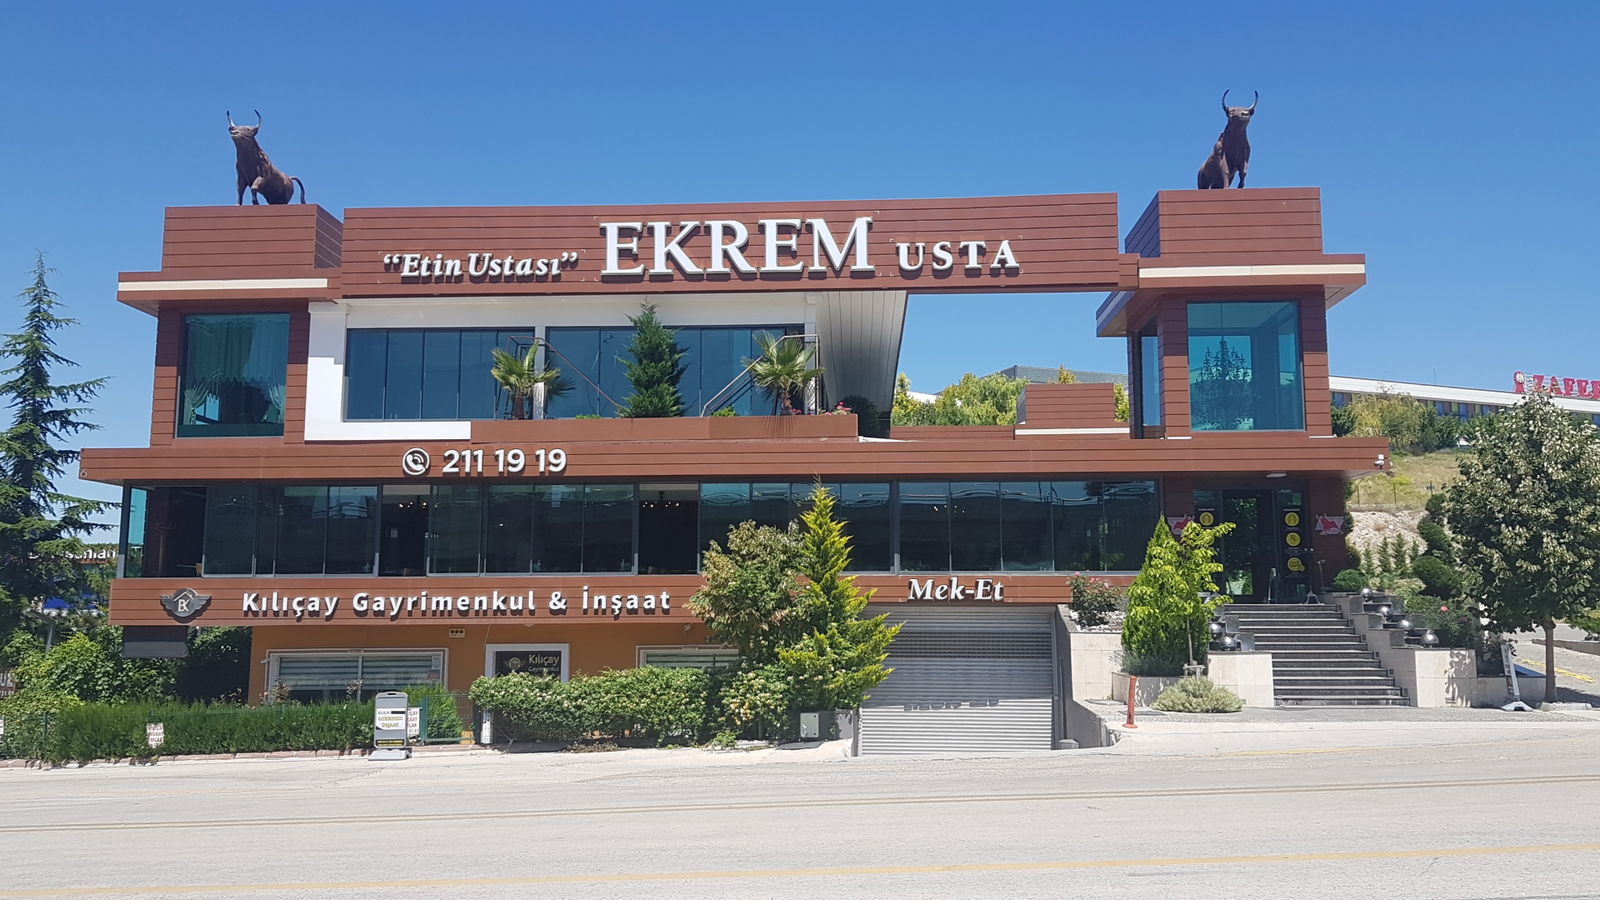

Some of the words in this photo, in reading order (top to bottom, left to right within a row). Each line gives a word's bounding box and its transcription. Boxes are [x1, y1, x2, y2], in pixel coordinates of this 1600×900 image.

[600, 215, 876, 276] EKREM
[896, 240, 1020, 272] USTA
[442, 449, 484, 473] 211
[494, 448, 526, 473] 19
[535, 448, 567, 473] 19
[242, 592, 338, 617] Kılıçay
[352, 590, 535, 616] Gayrimenkul
[549, 591, 567, 610] &
[582, 585, 670, 615] İnşaat
[908, 577, 1004, 601] Mek-Et
